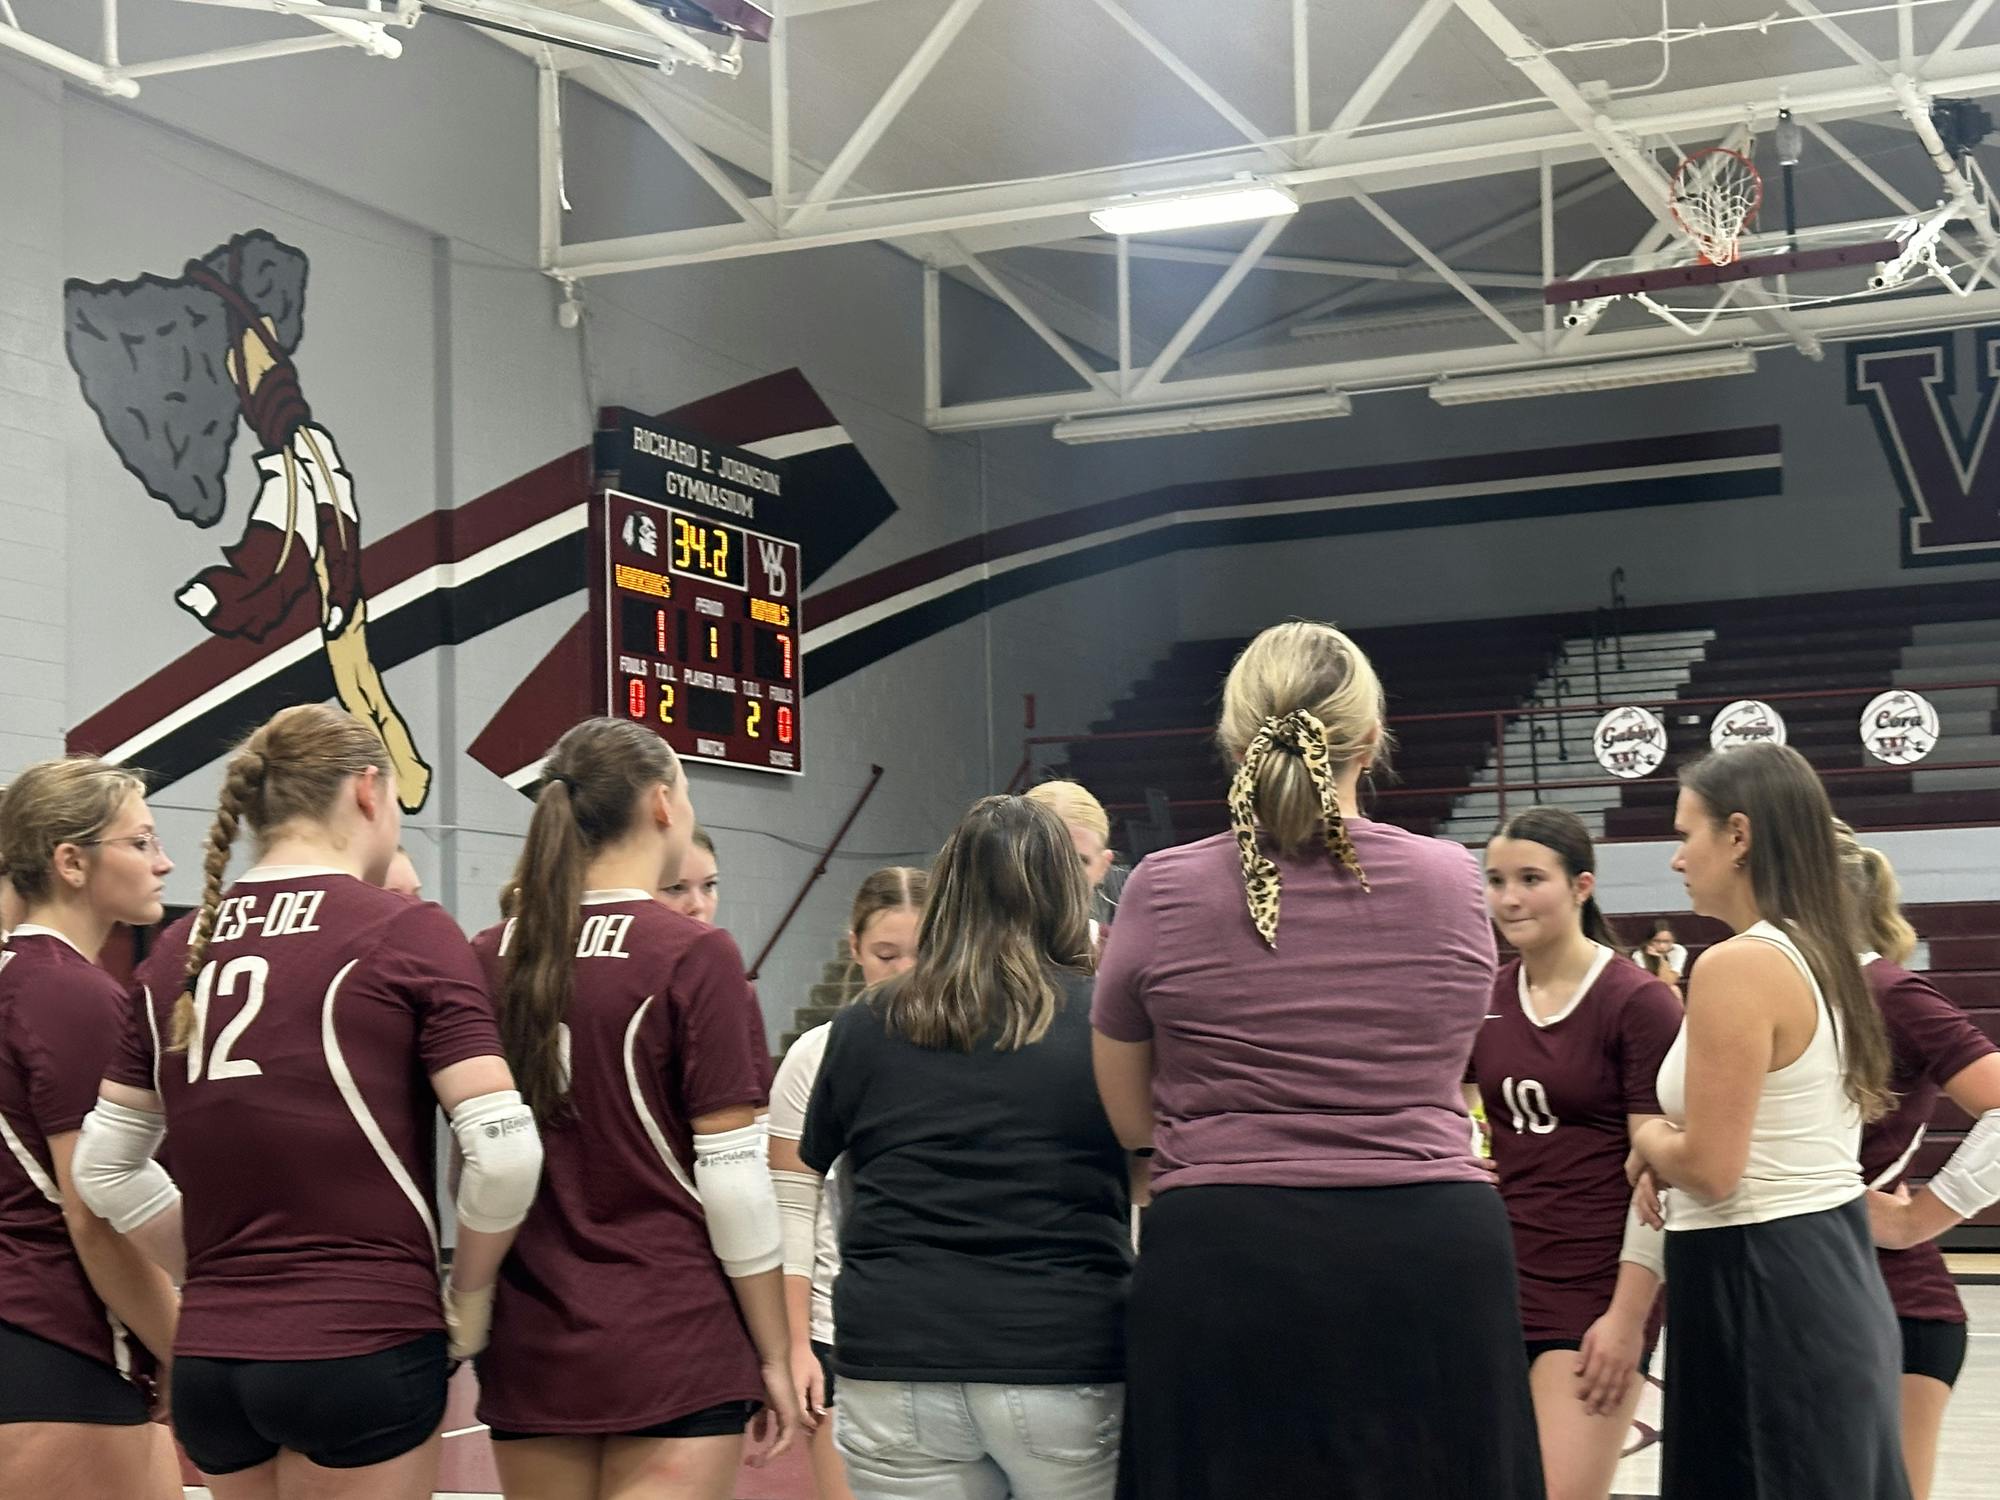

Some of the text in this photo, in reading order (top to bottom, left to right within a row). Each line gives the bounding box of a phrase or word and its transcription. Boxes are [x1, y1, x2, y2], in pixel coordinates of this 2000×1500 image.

[633, 426, 782, 496] RICHARD E. JOHNSON
[666, 470, 754, 519] GYMNASIUM
[674, 518, 728, 577] 34.2
[656, 609, 666, 652] 1
[709, 626, 718, 658] 1
[776, 633, 791, 679] 7
[629, 679, 646, 718] 0
[659, 684, 675, 723] 2
[746, 701, 761, 738] 2
[777, 706, 792, 744] 0
[187, 955, 269, 1084] 12
[1502, 1076, 1559, 1134] 10
